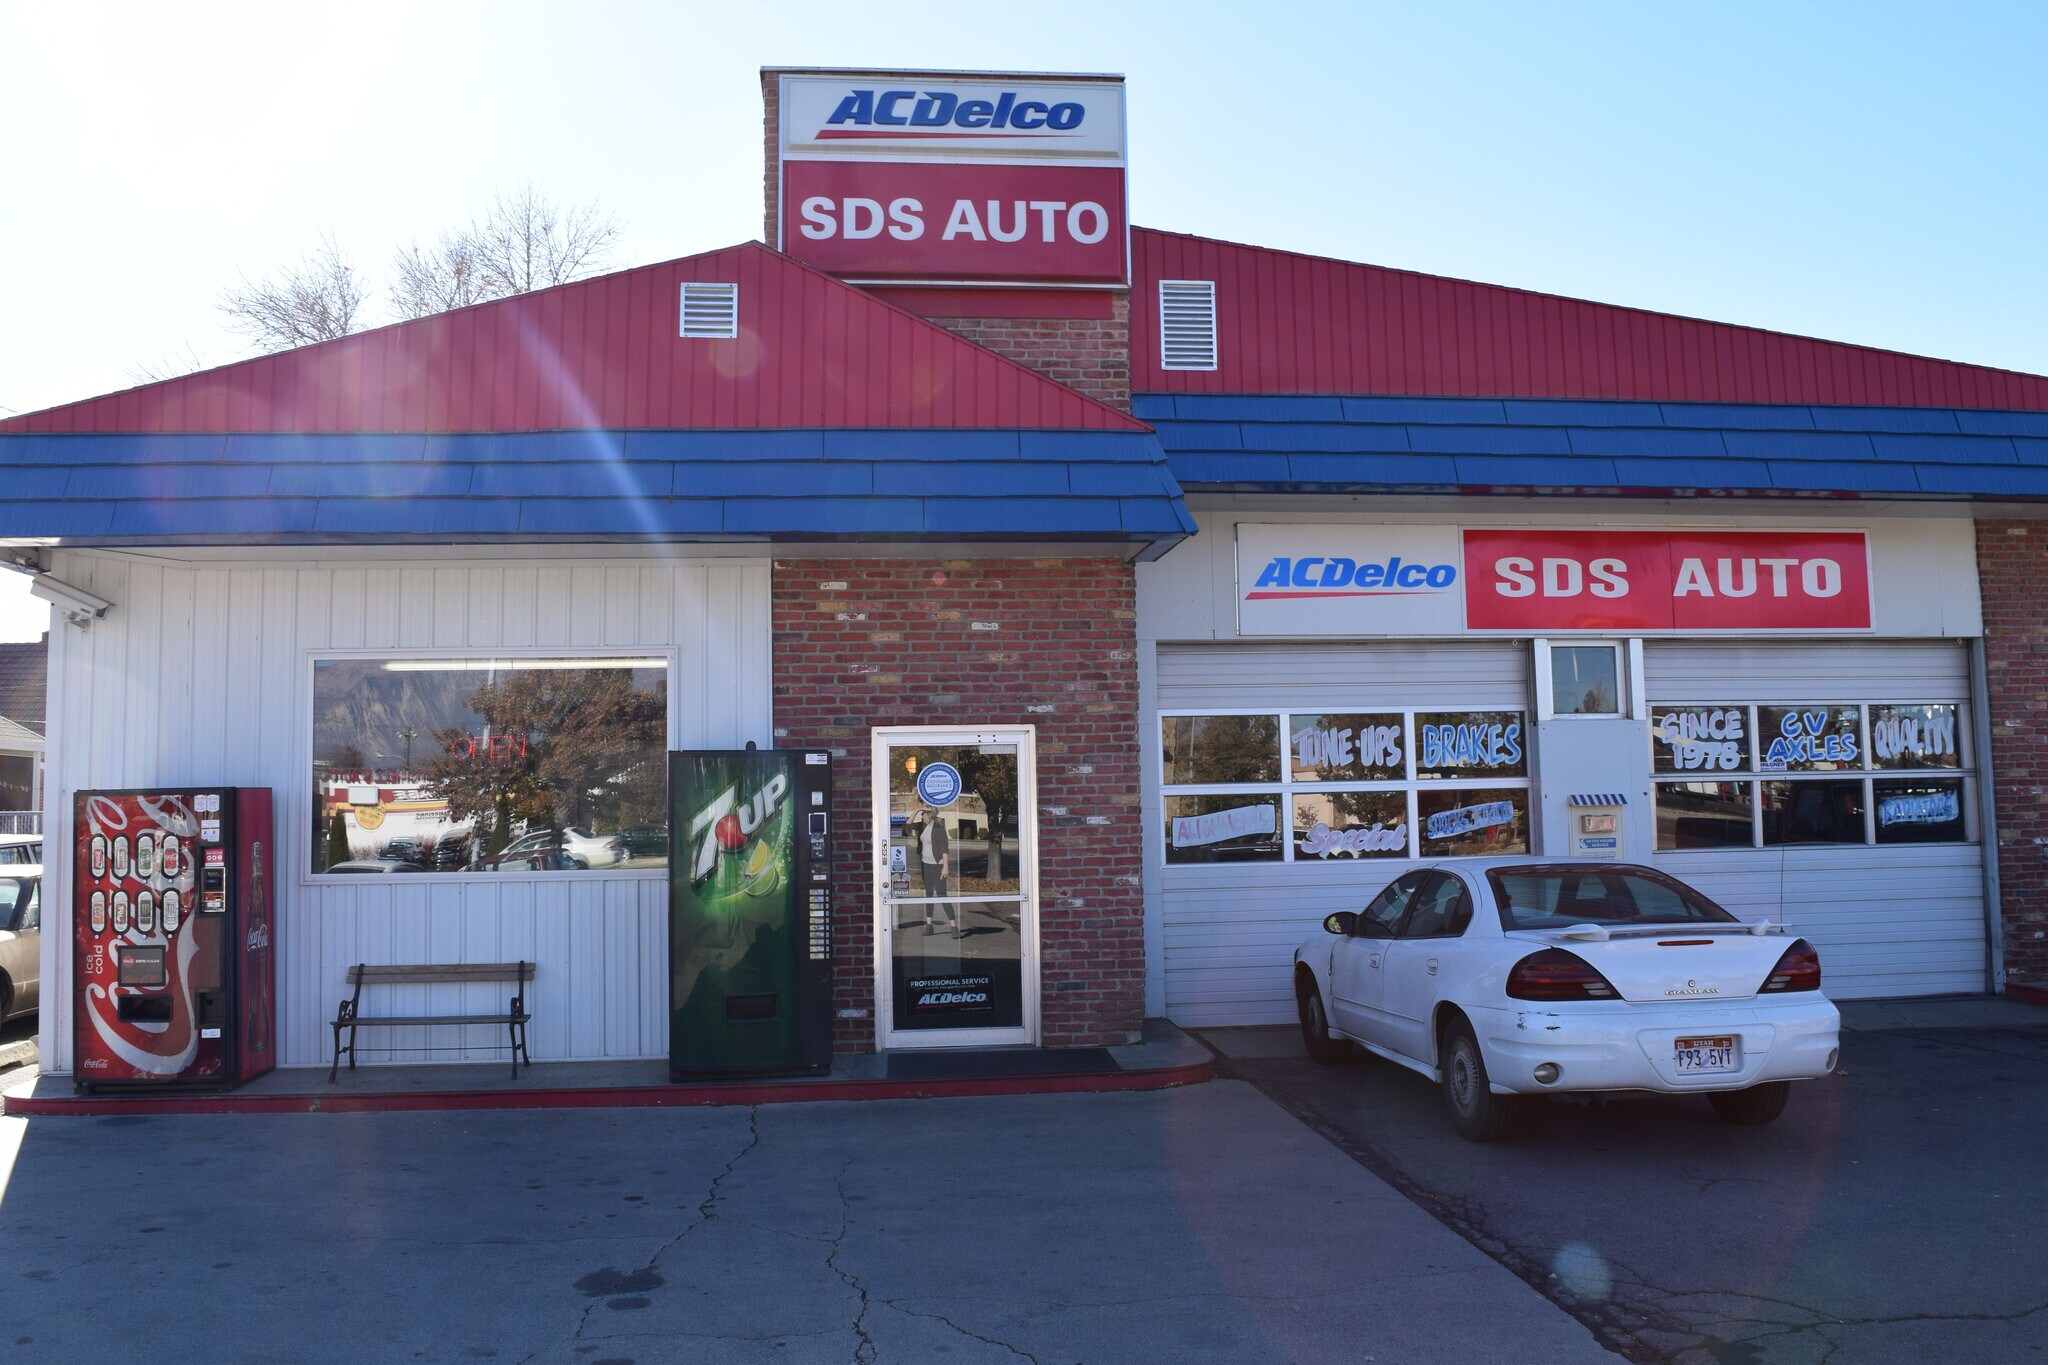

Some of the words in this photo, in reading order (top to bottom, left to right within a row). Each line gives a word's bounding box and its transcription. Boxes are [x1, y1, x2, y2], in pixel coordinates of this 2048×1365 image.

[826, 90, 1085, 130] ACDelco
[800, 196, 925, 241] SDS
[942, 200, 1109, 244] AUTO
[1254, 557, 1456, 589] ACDelco
[1495, 557, 1630, 598] SDS
[1673, 558, 1842, 598] AUTO
[1660, 711, 1744, 744] SINCE
[1781, 712, 1828, 738] CV
[1874, 717, 1955, 759] QUALITY
[450, 735, 527, 760] OPEN
[1292, 725, 1402, 768] TUNE-UPS
[1423, 724, 1522, 768] BRAKES
[1672, 741, 1740, 770] 1978
[1766, 733, 1857, 762] AXLES
[1301, 822, 1406, 860] Special
[85, 954, 94, 974] ice
[94, 945, 103, 974] cold
[910, 979, 960, 987] PROFESSIONAL
[961, 977, 989, 985] SERVICE
[917, 991, 987, 1005] ACDelco
[1678, 1050, 1702, 1067] F93
[1709, 1048, 1732, 1065] 5VT
